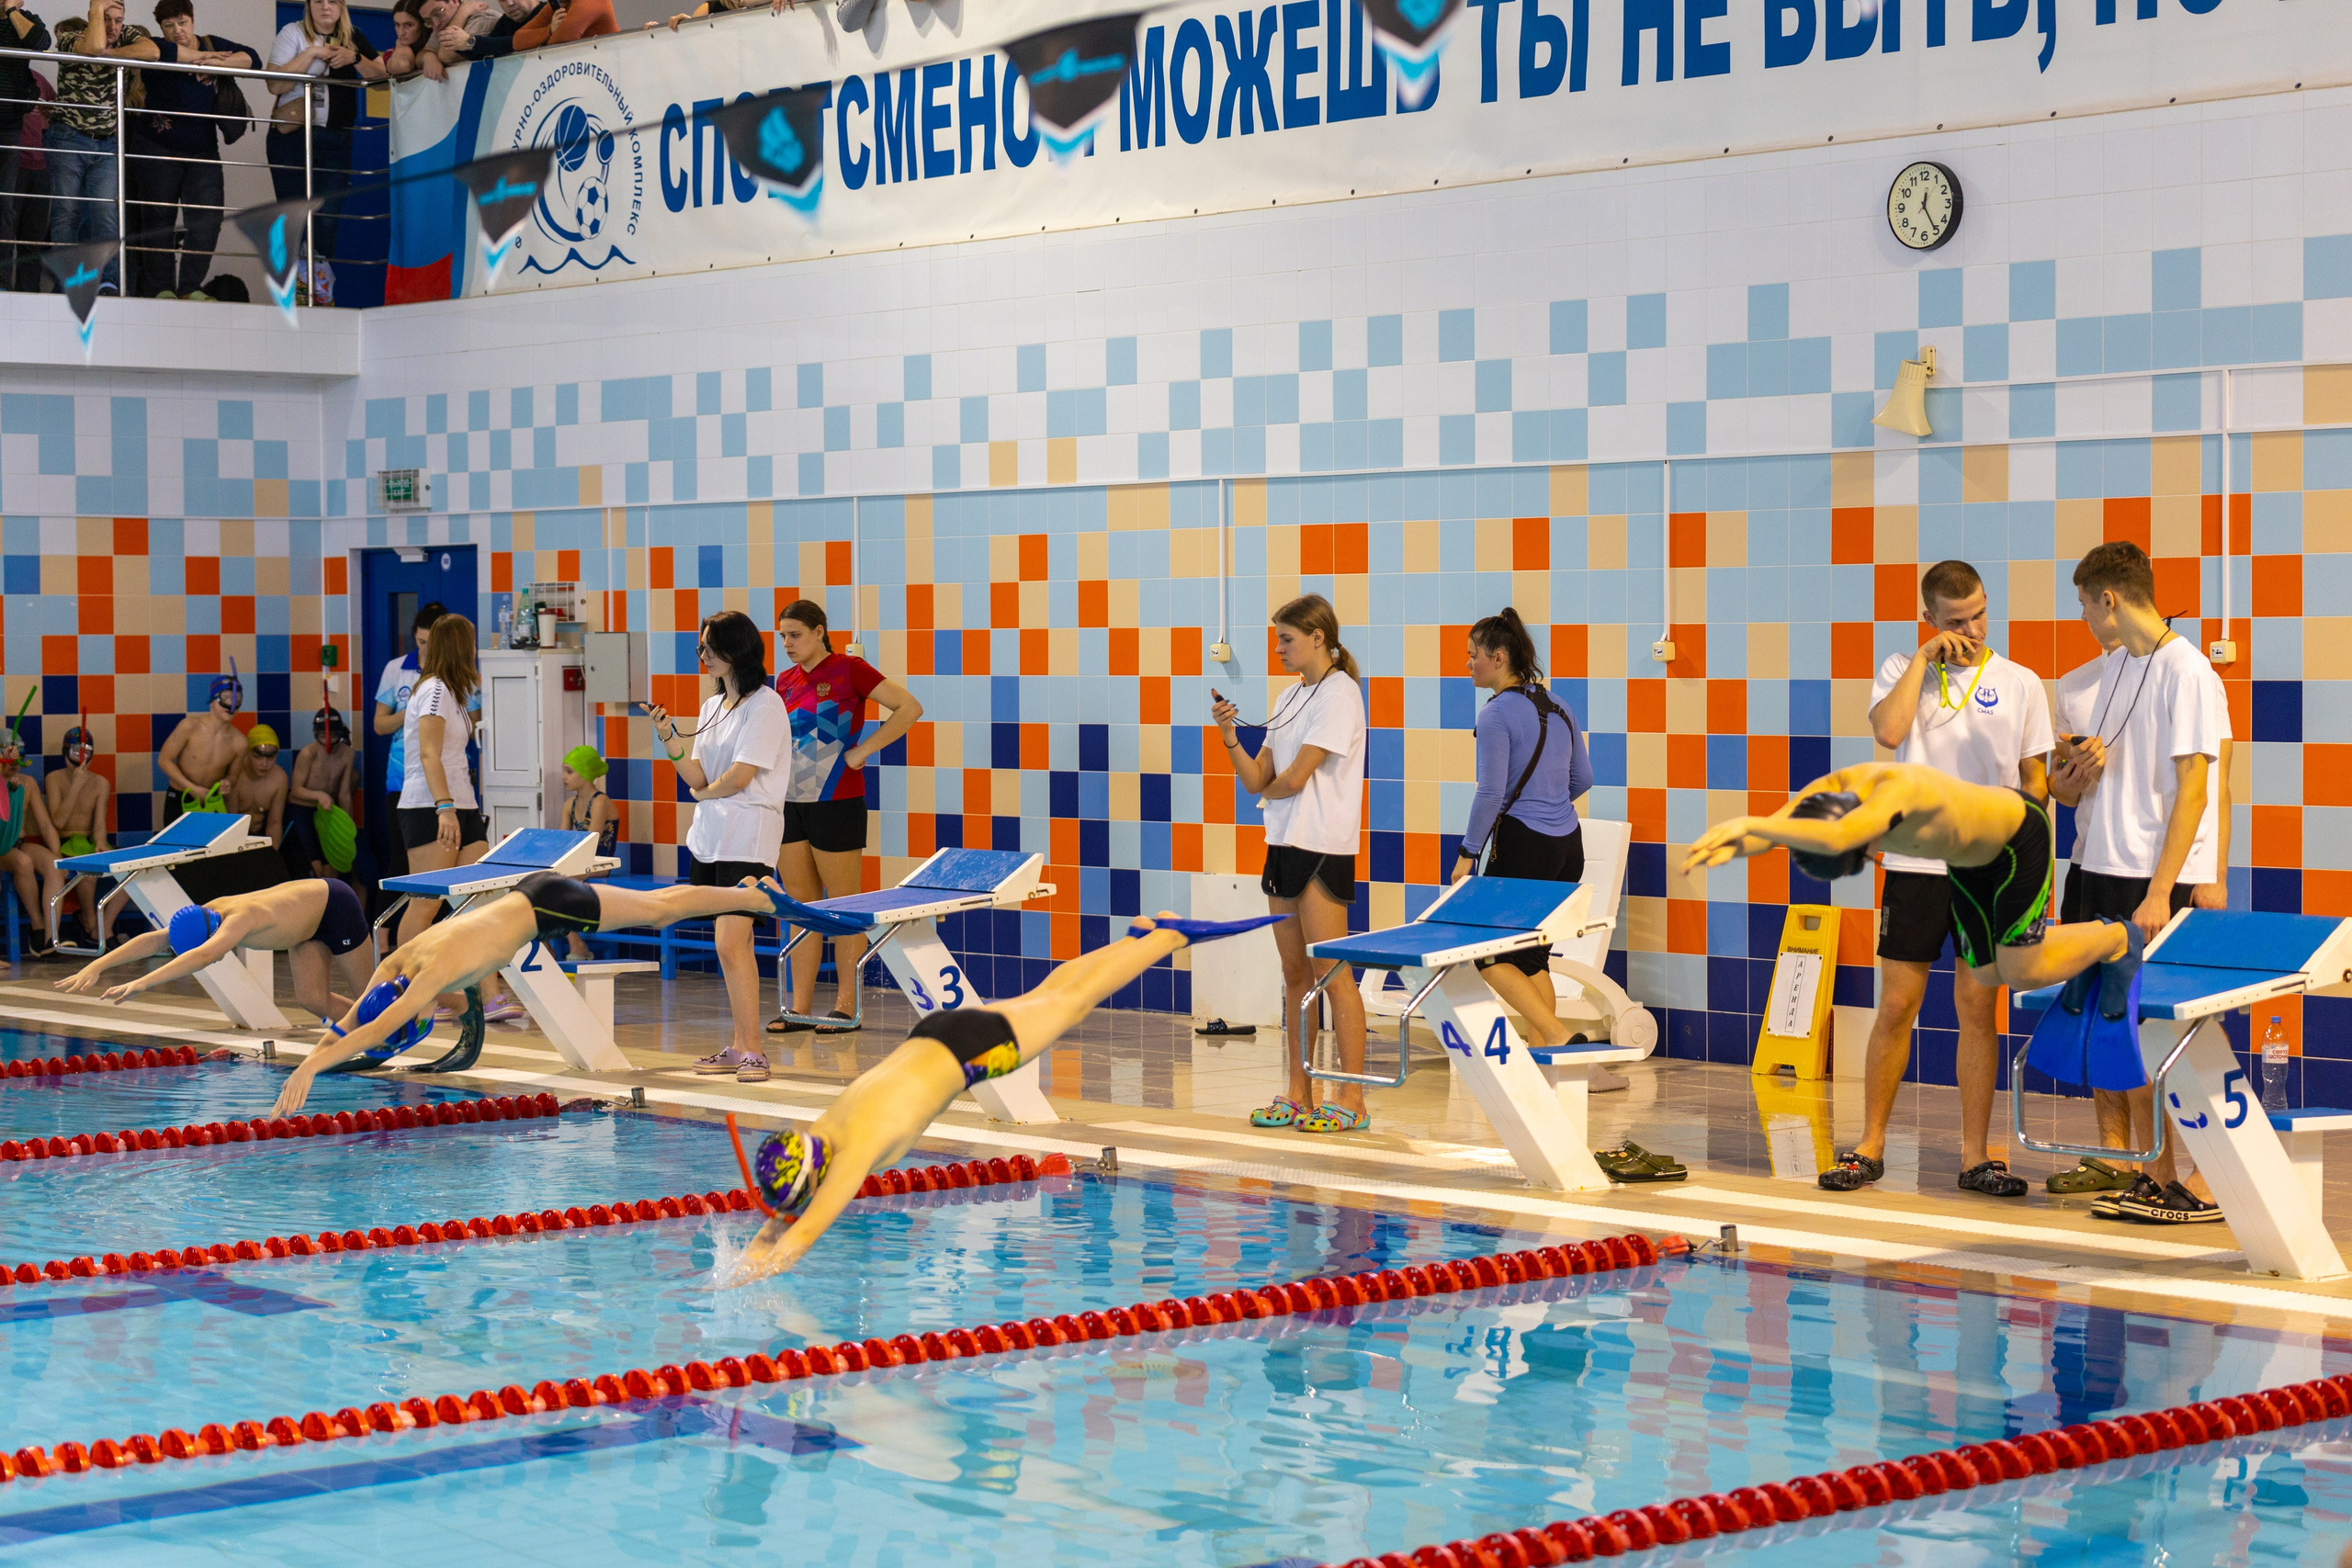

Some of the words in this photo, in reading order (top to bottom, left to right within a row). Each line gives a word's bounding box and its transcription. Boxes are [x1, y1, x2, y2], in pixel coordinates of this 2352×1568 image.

[1467, 0, 1589, 104] ТЫ
[1622, 0, 1730, 86] НЕ
[1909, 176, 1917, 186] 11
[1919, 171, 1929, 181] 12
[1934, 175, 1939, 184] 1
[628, 127, 643, 236] КОМПЛЕКС
[1901, 187, 1911, 198] 10
[1940, 185, 1948, 195] 2
[1897, 203, 1905, 213] 9
[1945, 198, 1951, 209] 3
[1902, 218, 1909, 228] 8
[1940, 214, 1948, 224] 4
[1910, 227, 1917, 237] 7
[1932, 225, 1939, 235] 5
[1921, 231, 1928, 241] 6
[1977, 707, 1994, 716] CMAS
[1786, 945, 1820, 955] ВНИМАНИЕ
[521, 939, 542, 972] 2
[939, 964, 965, 1010] 3
[1788, 961, 1804, 1027] АРЕНДА
[1441, 1021, 1473, 1057] 4
[1485, 1016, 1510, 1065] 4
[2223, 1068, 2248, 1130] 5
[2151, 1209, 2189, 1221] crocs
